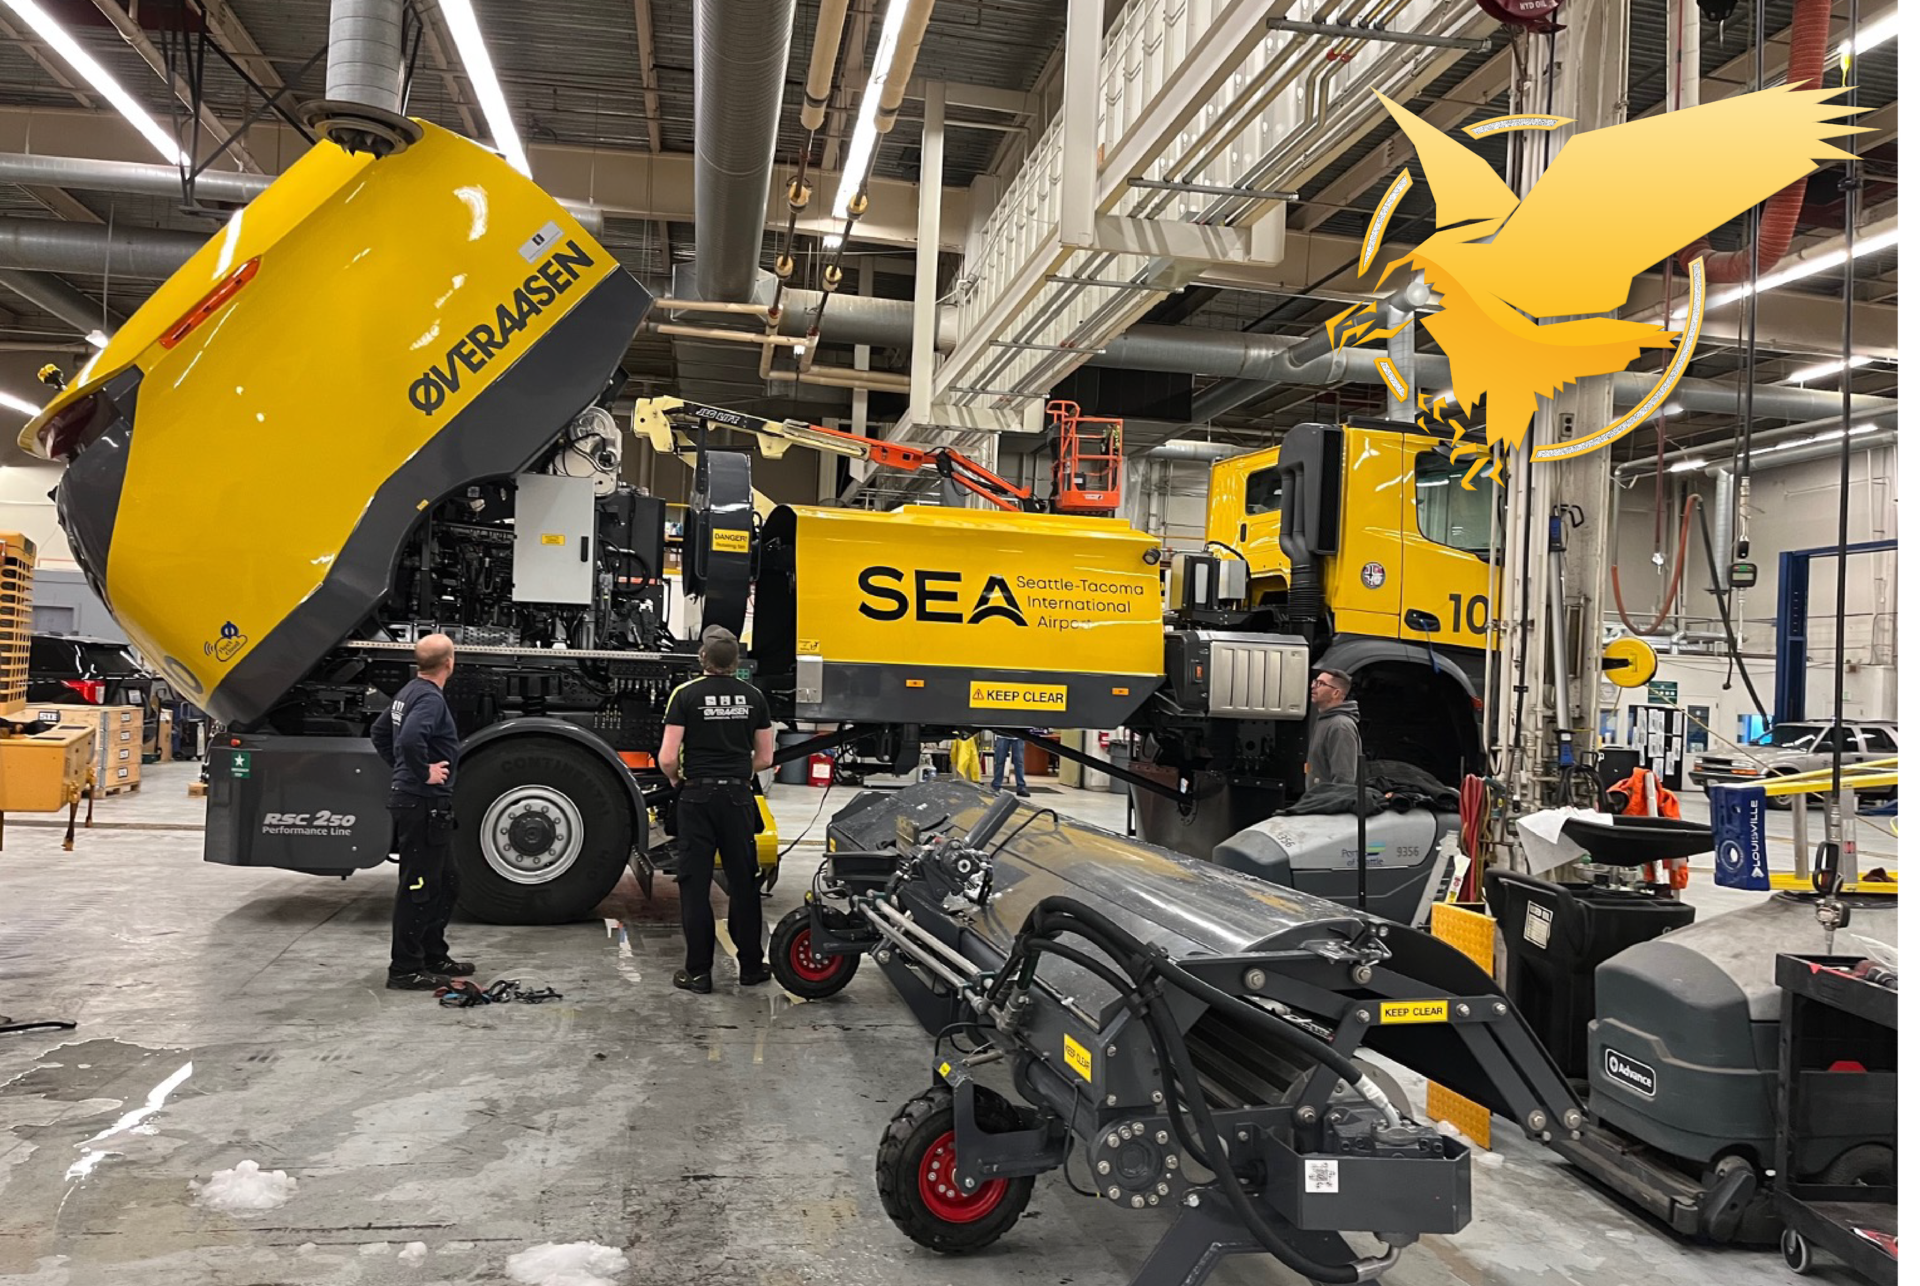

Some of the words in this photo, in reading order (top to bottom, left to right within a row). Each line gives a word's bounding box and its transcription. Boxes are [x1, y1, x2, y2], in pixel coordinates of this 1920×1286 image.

[408, 239, 595, 416] ØVERAASEN
[857, 565, 1028, 625] SEA
[1016, 575, 1145, 596] Seattle-Tacoma
[1027, 595, 1131, 613] International
[1448, 593, 1489, 635] 10
[986, 689, 1020, 702] KEEP
[1023, 691, 1065, 704] CLEAR
[263, 812, 310, 825] RSC
[312, 810, 357, 827] 250
[262, 826, 328, 836] Performance
[330, 827, 353, 836] Line
[1749, 799, 1761, 867] LOUISVILLE
[1396, 846, 1420, 858] 9356
[1385, 1008, 1410, 1017] KEEP
[1412, 1007, 1444, 1016] CLEAR
[1618, 1062, 1653, 1088] Advance
